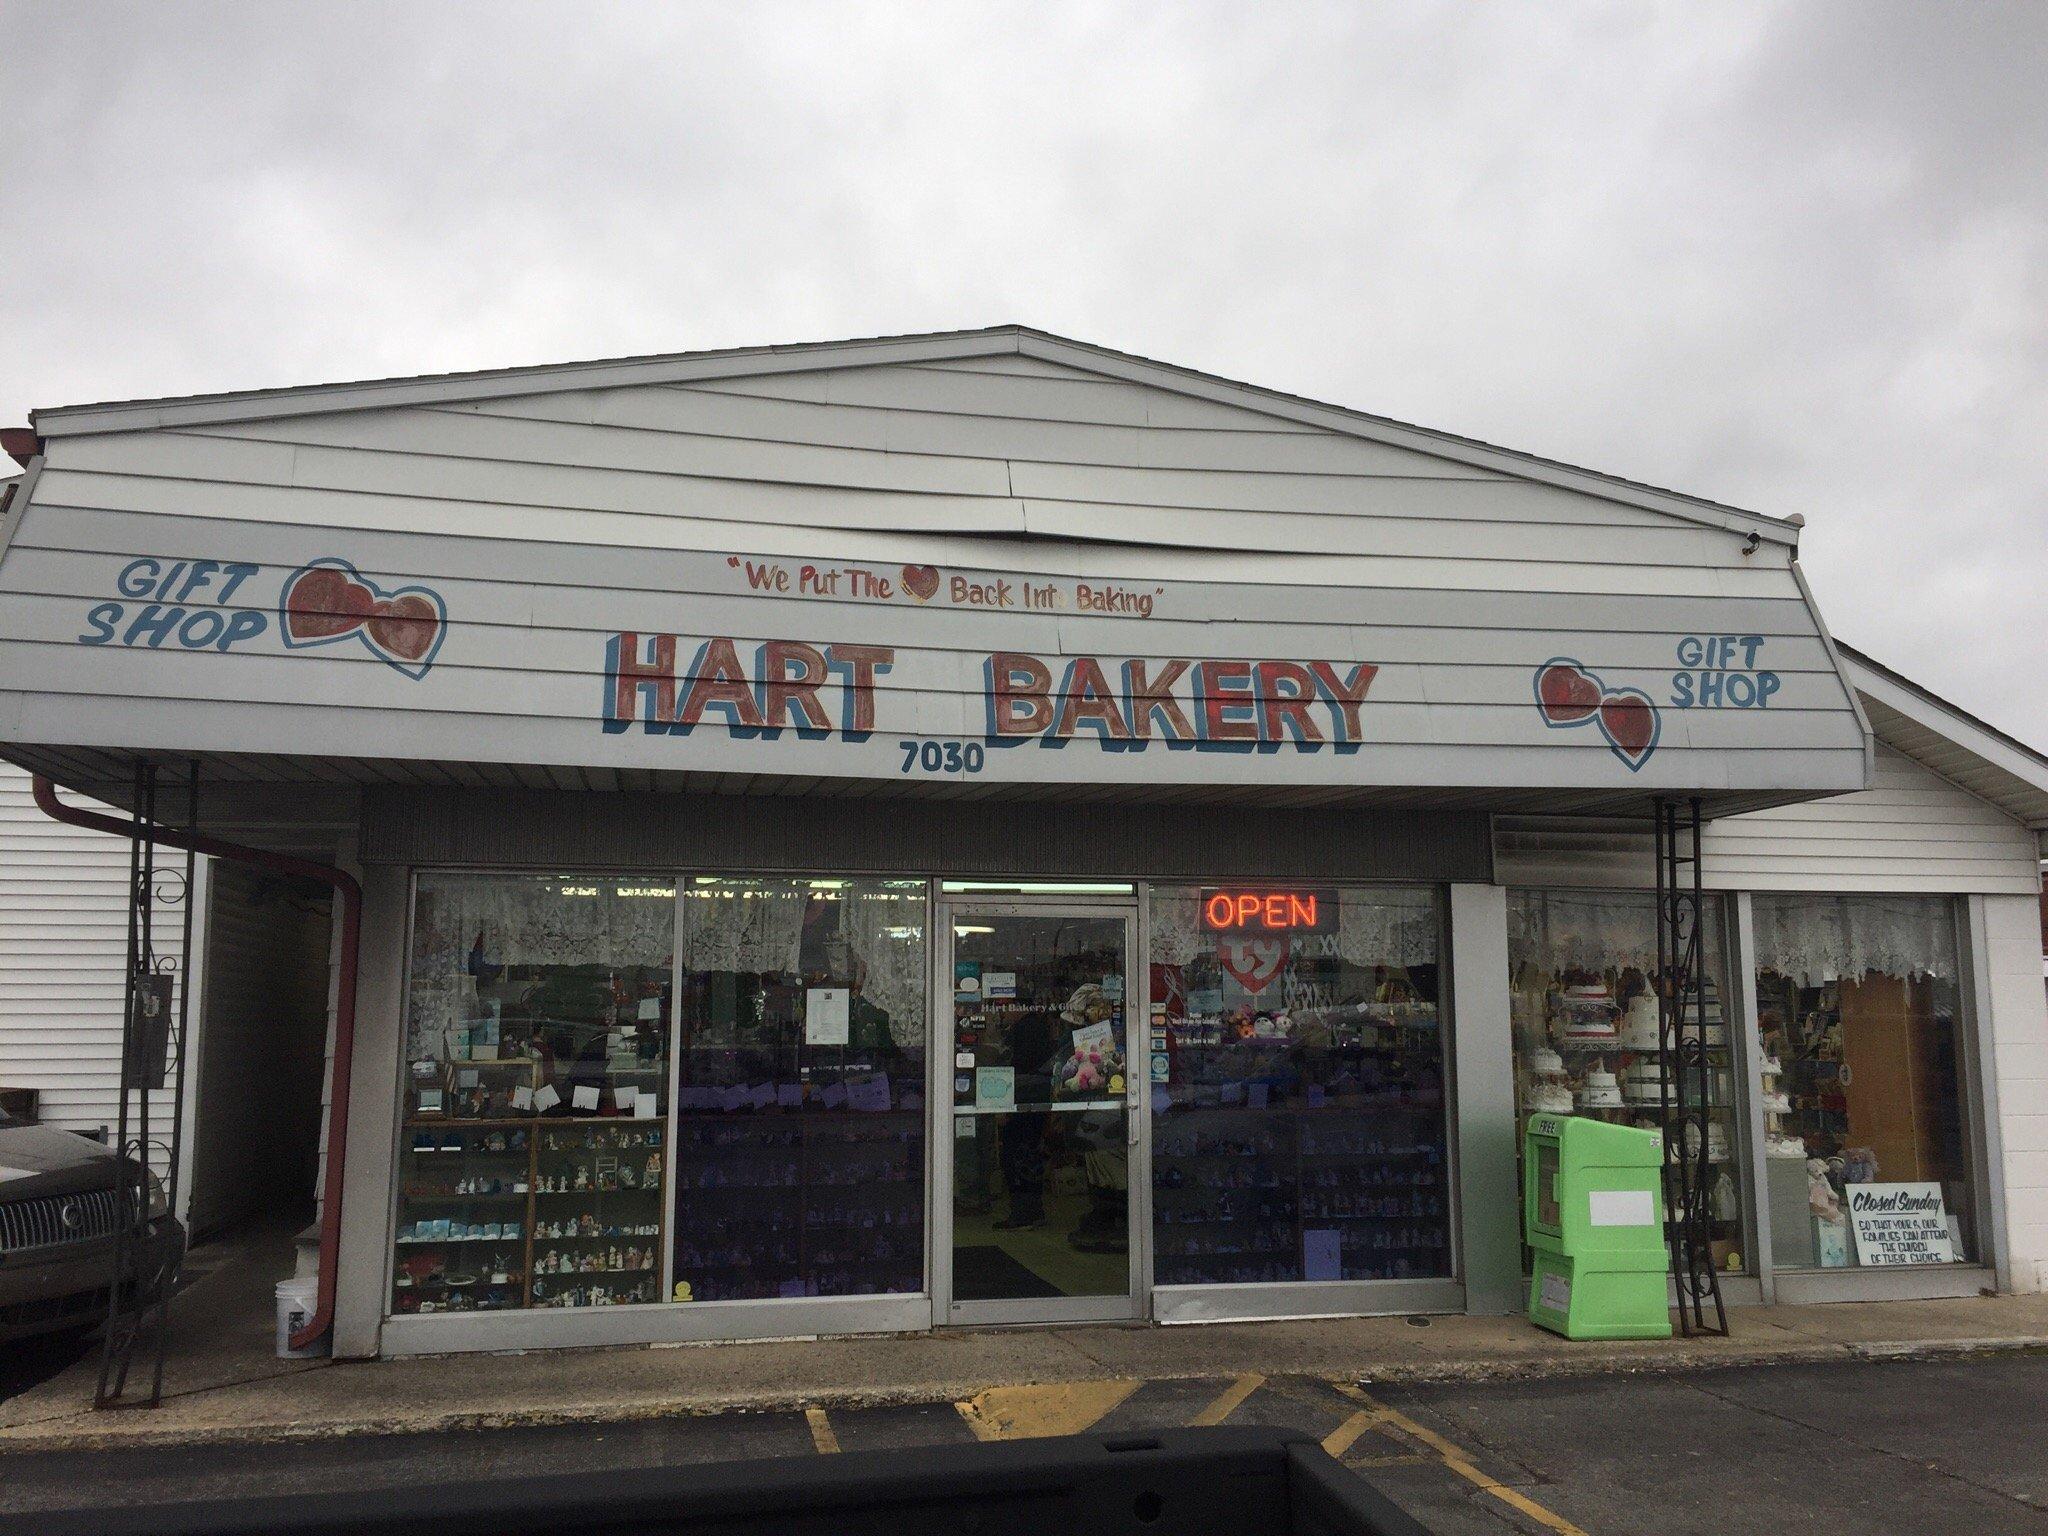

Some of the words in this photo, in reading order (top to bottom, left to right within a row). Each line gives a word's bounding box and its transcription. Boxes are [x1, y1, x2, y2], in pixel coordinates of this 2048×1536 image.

[117, 558, 259, 604] GIFT
[800, 565, 841, 595] Put
[843, 568, 893, 599] The
[950, 576, 1014, 608] Back
[78, 603, 268, 652] SHOP
[1677, 636, 1765, 670] GIFT
[602, 631, 894, 742] HART
[983, 653, 1379, 754] BAKERY
[1671, 672, 1781, 709] SHOP
[899, 740, 984, 773] 7030
[1206, 893, 1317, 928] OPEN
[981, 1002, 1006, 1013] Hart
[1008, 1003, 1047, 1013] Bakery
[1048, 1002, 1057, 1011] &
[1539, 1120, 1555, 1133] FREE
[1853, 1191, 1899, 1212] Closed
[1897, 1189, 1941, 1217] Sunday
[1902, 1230, 1919, 1241] CAN
[1920, 1229, 1948, 1240] ATTEND
[1921, 1219, 1939, 1229] OUR
[1871, 1254, 1882, 1264] OF
[1883, 1254, 1907, 1264] THEIR
[1909, 1252, 1942, 1263] CHOICE
[1879, 1243, 1896, 1253] THE
